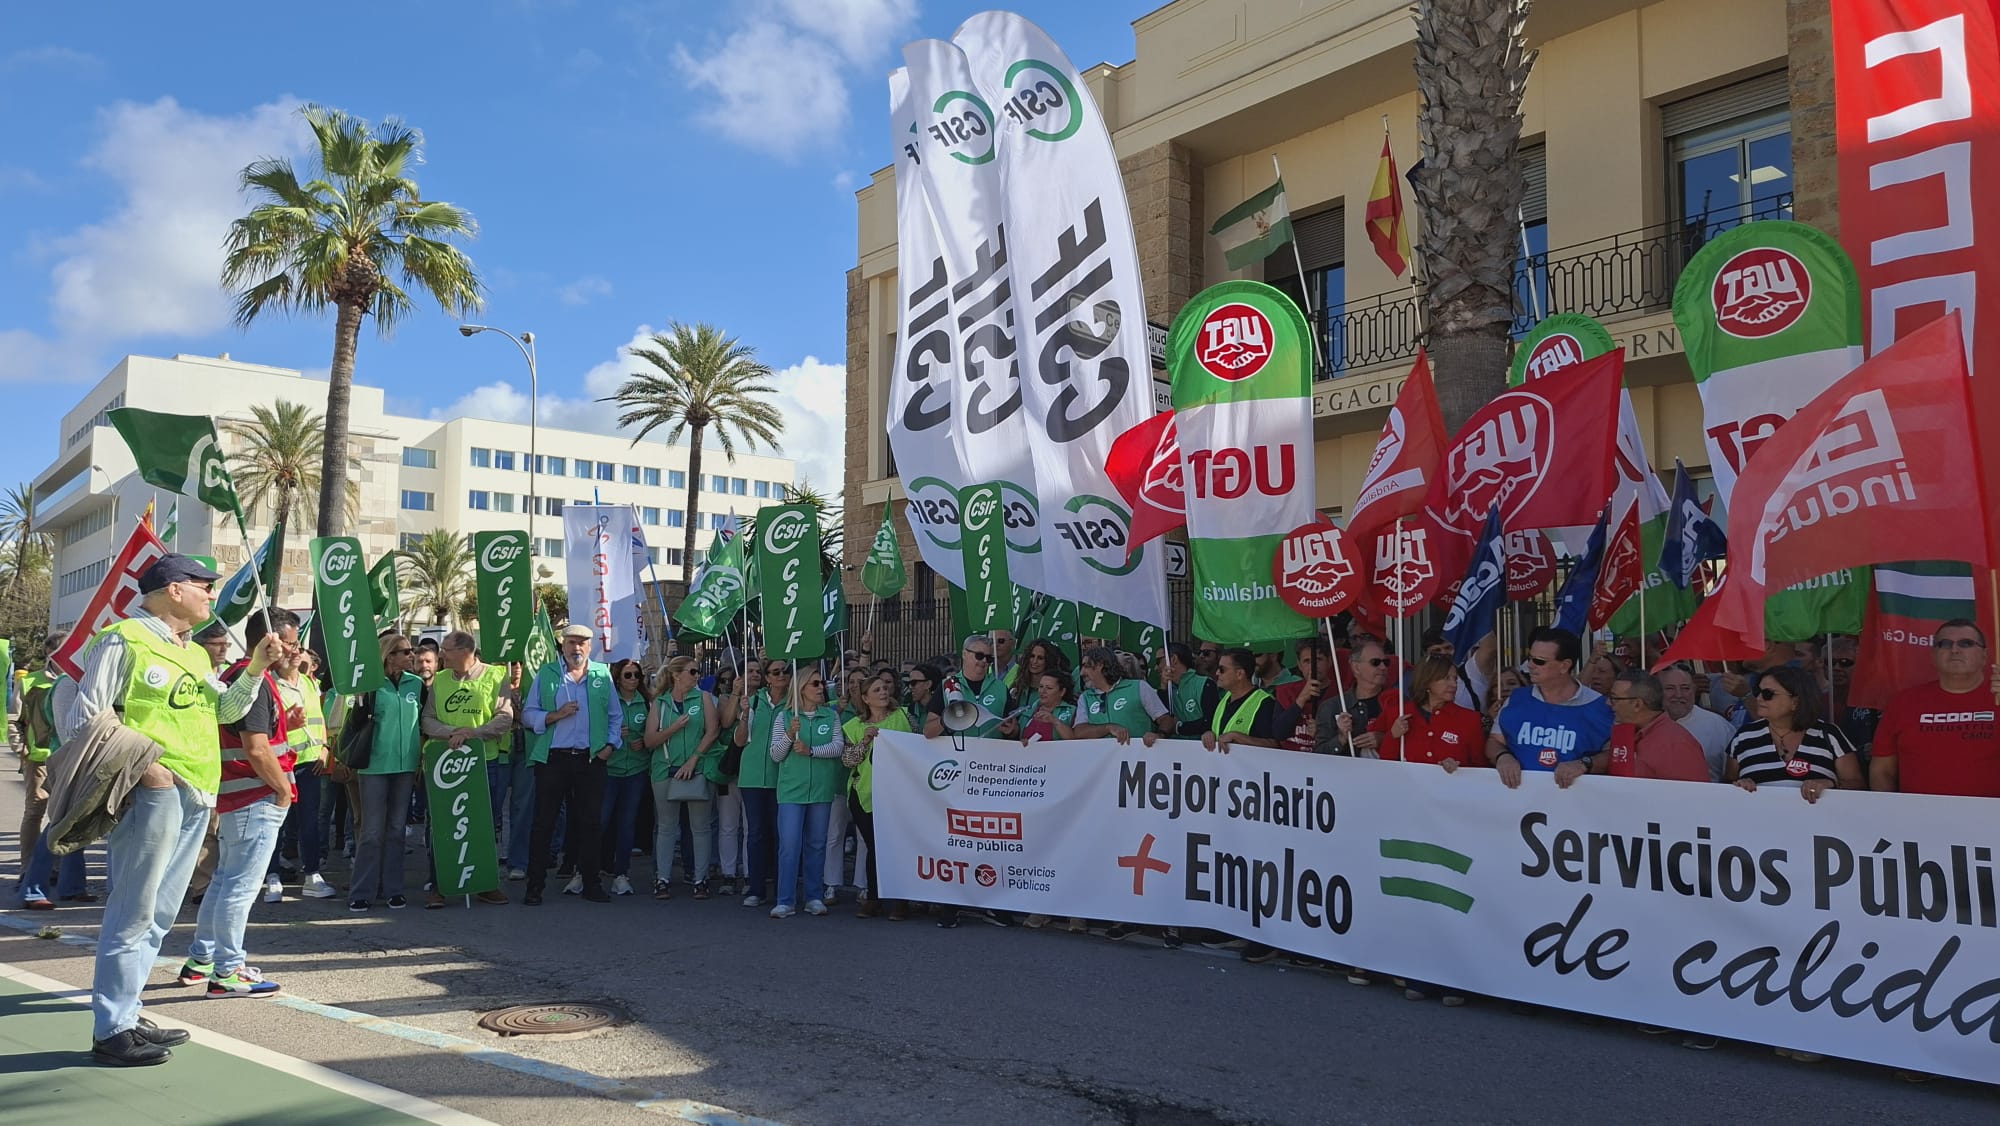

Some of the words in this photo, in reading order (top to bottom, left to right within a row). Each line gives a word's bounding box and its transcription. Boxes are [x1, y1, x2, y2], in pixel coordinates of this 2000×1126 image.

[971, 499, 997, 517] CSIF
[774, 523, 811, 540] CSIF
[1505, 529, 1541, 557] GT
[490, 546, 524, 561] CSIF
[1283, 529, 1345, 573] UGT
[1375, 528, 1428, 569] UGT
[327, 554, 358, 571] CSIF
[978, 534, 997, 625] CSIF
[497, 576, 515, 658] CSIF
[783, 558, 803, 654] CSIF
[339, 590, 365, 688] CSIF
[1920, 711, 1973, 723] CCOO
[1517, 721, 1577, 754] Acaip
[442, 756, 478, 775] CSIF
[934, 767, 962, 782] CSIF
[969, 761, 1006, 773] Central
[1008, 764, 1047, 774] Sindical
[966, 787, 980, 796] de
[982, 788, 1045, 798] Funcionarios
[967, 774, 1038, 787] Independiente
[1040, 778, 1046, 788] y
[1118, 760, 1220, 820] Mejor
[1227, 771, 1336, 833] salario
[951, 813, 1017, 835] CCOO
[452, 792, 475, 889] CSIF
[947, 836, 973, 849] área
[976, 839, 1024, 853] pública
[917, 855, 969, 885] UGT
[1519, 811, 1792, 907] Servicios
[1007, 865, 1056, 879] Servicios
[1185, 832, 1353, 935] Empleo
[1008, 878, 1050, 892] Públicos
[1523, 893, 1631, 980] de
